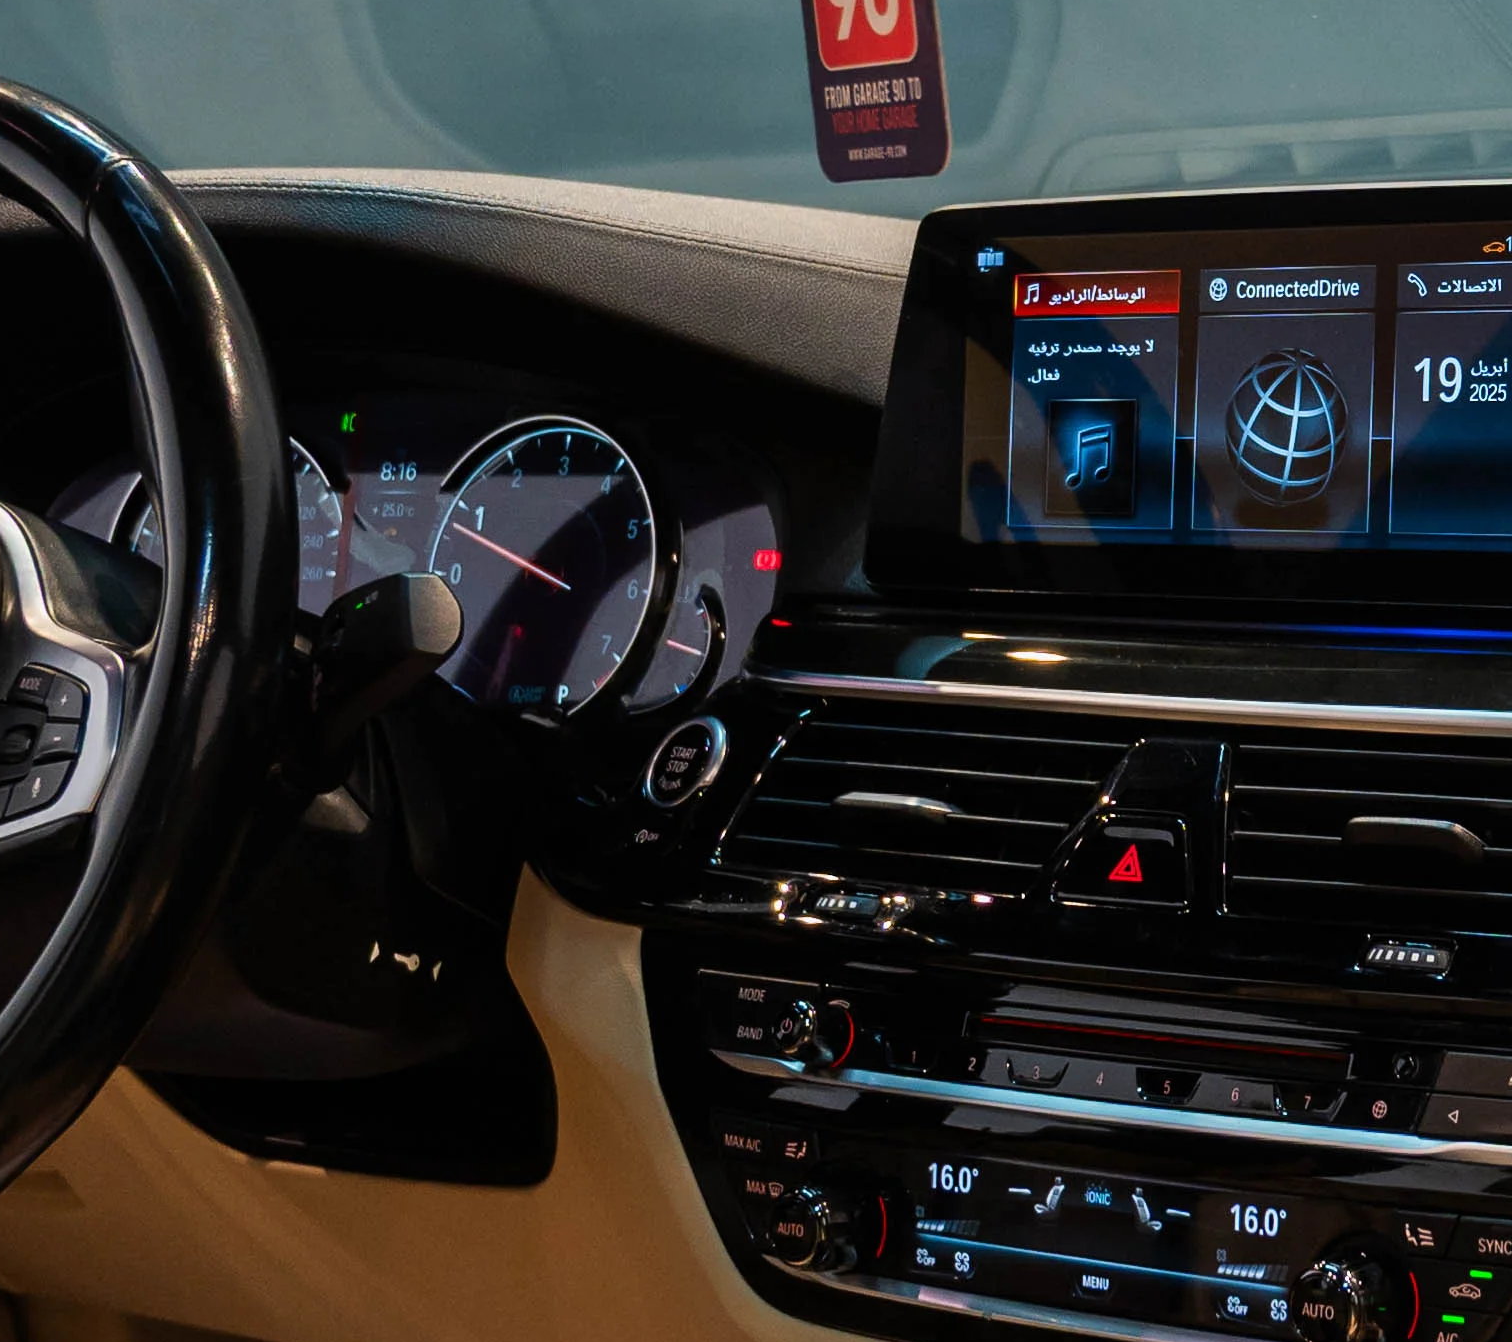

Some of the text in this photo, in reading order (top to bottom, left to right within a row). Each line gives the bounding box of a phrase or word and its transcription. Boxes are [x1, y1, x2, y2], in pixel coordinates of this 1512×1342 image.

[824, 76, 922, 110] FROM GARAGE 90 TO
[1236, 278, 1361, 300] ConnectedDrive
[1437, 278, 1503, 294] الاتصالات
[1028, 338, 1155, 357] لا يوجد مصدر ترفيه
[1470, 357, 1509, 377] أبريل
[1413, 356, 1464, 404] 19
[1468, 383, 1508, 403] 2025
[380, 462, 417, 481] 8:16
[559, 455, 570, 476] 3
[511, 468, 523, 489] 2
[600, 475, 611, 496] 4
[474, 505, 486, 532] 1
[626, 519, 639, 540] 5
[450, 562, 462, 585] 0
[626, 578, 638, 600] 6
[601, 634, 612, 656] 7
[557, 684, 569, 705] P
[669, 746, 697, 760] START
[666, 759, 689, 773] STOP
[738, 986, 766, 1003] MODE
[736, 1025, 763, 1041] BAND
[910, 1049, 917, 1064] 1
[967, 1056, 977, 1072] 2
[1032, 1065, 1041, 1081] 3
[1095, 1071, 1105, 1087] 4
[1162, 1079, 1172, 1095] 5
[1230, 1086, 1240, 1102] 6
[1303, 1095, 1313, 1111] 7
[724, 1132, 744, 1149] MAX
[745, 1178, 766, 1196] MAX
[777, 1221, 804, 1238] AUTO
[1477, 1237, 1512, 1256] SYNC
[1081, 1274, 1110, 1291] MENU
[1301, 1302, 1335, 1321] AUTO
